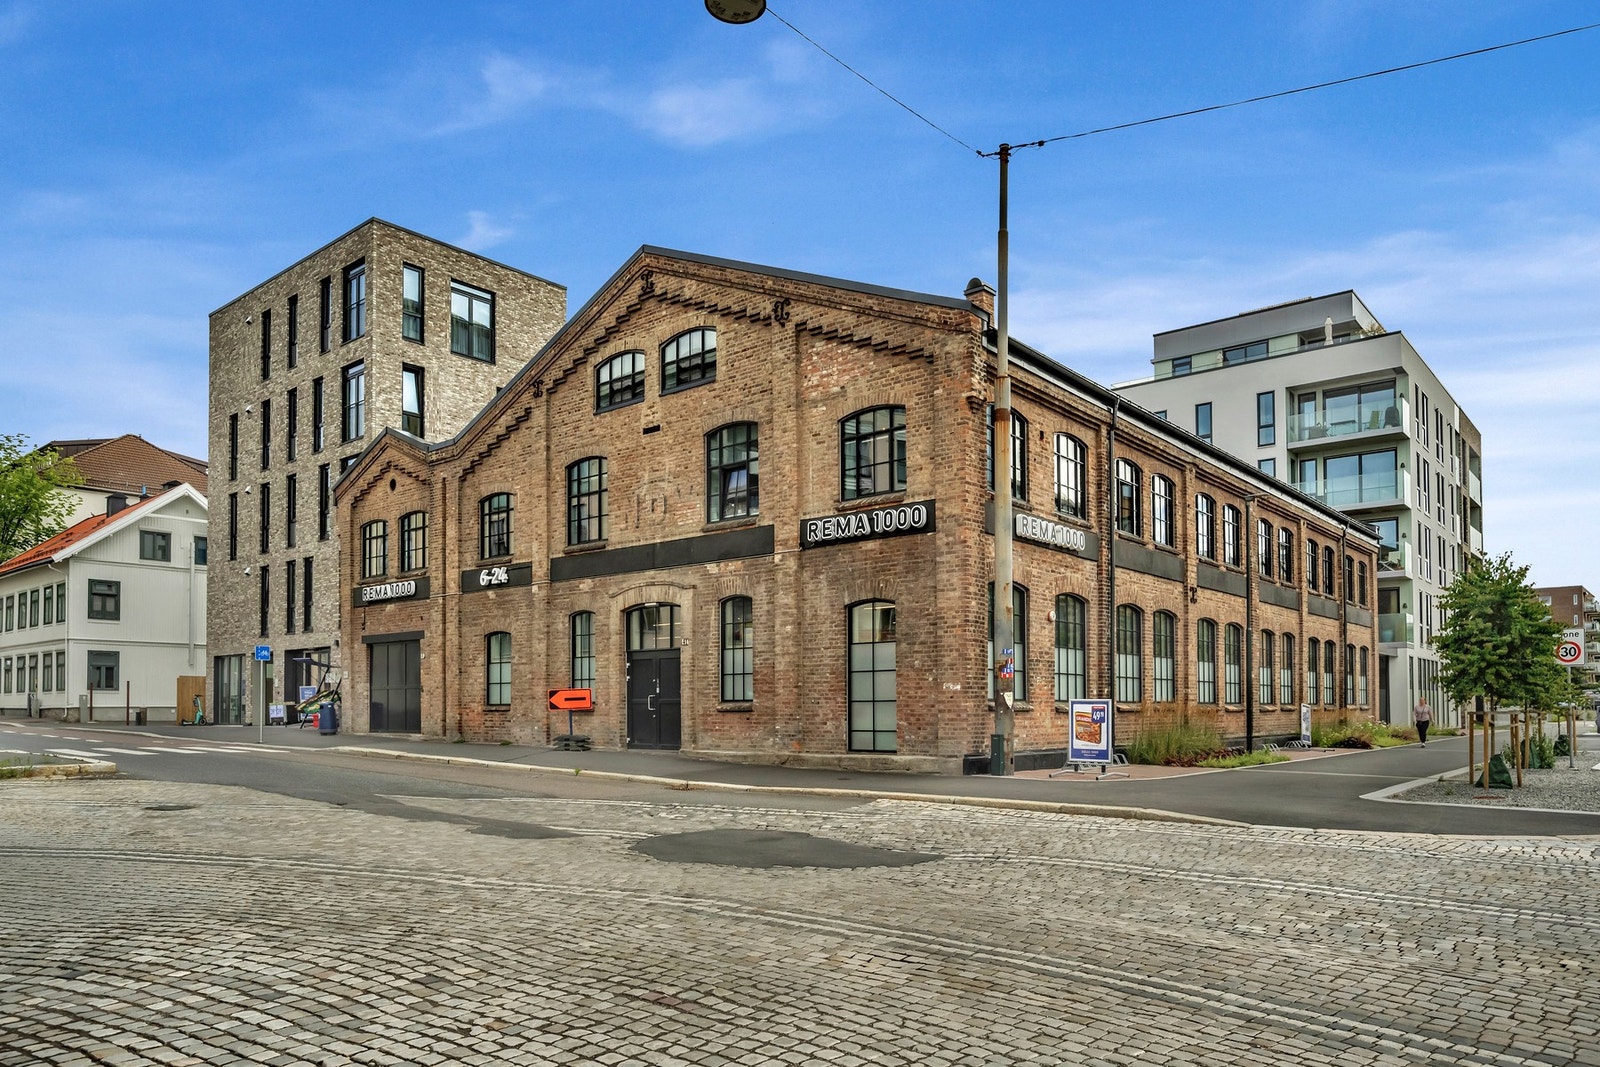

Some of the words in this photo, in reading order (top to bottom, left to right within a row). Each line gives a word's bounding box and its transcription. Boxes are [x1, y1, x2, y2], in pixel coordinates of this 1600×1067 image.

[807, 513, 870, 541] REMA
[873, 505, 927, 534] 1000
[1016, 514, 1057, 544] REMA
[1056, 525, 1086, 552] 1000
[480, 566, 509, 586] 6-24
[362, 584, 391, 601] REMA
[390, 580, 416, 598] 1000
[1560, 646, 1577, 658] 30
